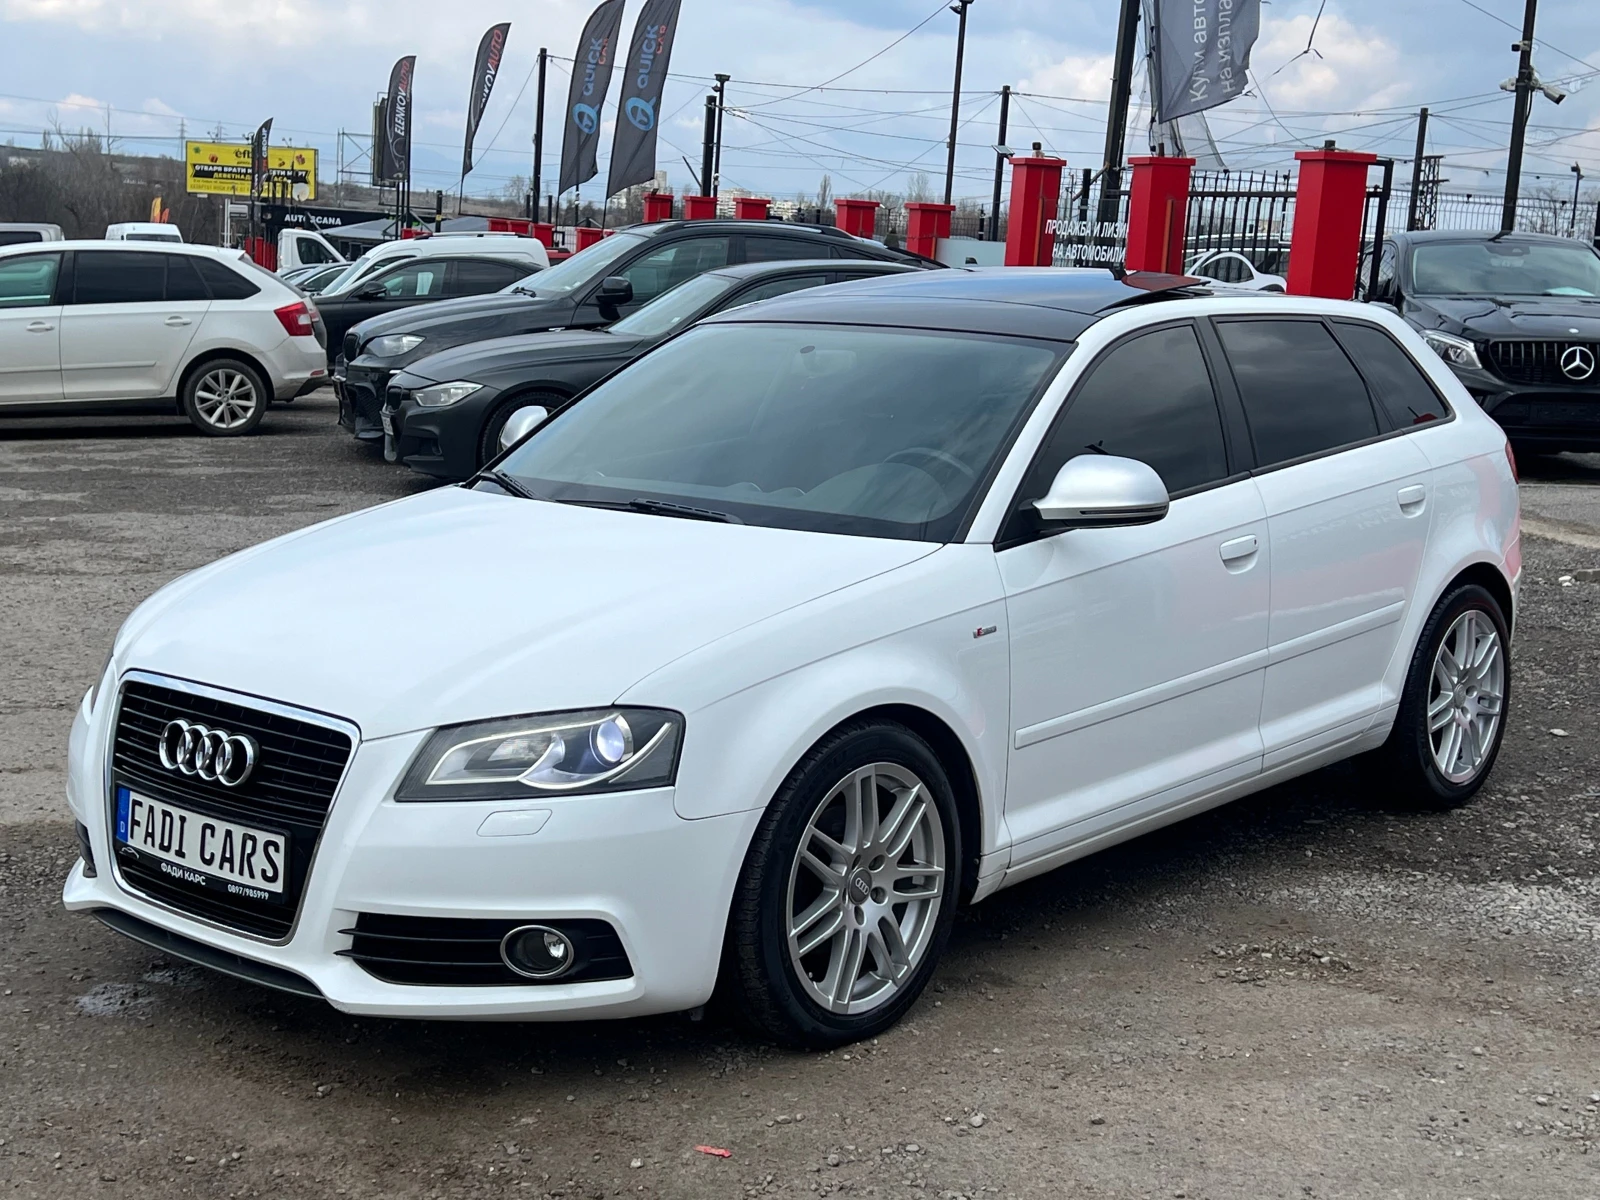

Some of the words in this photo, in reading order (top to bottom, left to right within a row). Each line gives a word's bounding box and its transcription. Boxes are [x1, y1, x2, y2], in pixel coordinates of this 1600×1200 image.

[583, 38, 603, 96] QUICK
[637, 25, 659, 89] QUICK
[1220, 67, 1236, 93] на
[1045, 219, 1092, 240] ПРОДАЖБА
[1093, 221, 1101, 237] И
[1101, 221, 1128, 238] ЛИЗИ
[1052, 243, 1064, 258] НА
[1065, 244, 1126, 262] АВТОМОБИЛИ
[129, 798, 187, 859] FADI
[200, 822, 280, 884] CARS
[160, 863, 184, 879] ФАДИ
[184, 869, 206, 886] КАРС
[227, 884, 269, 900] 0897/985999
